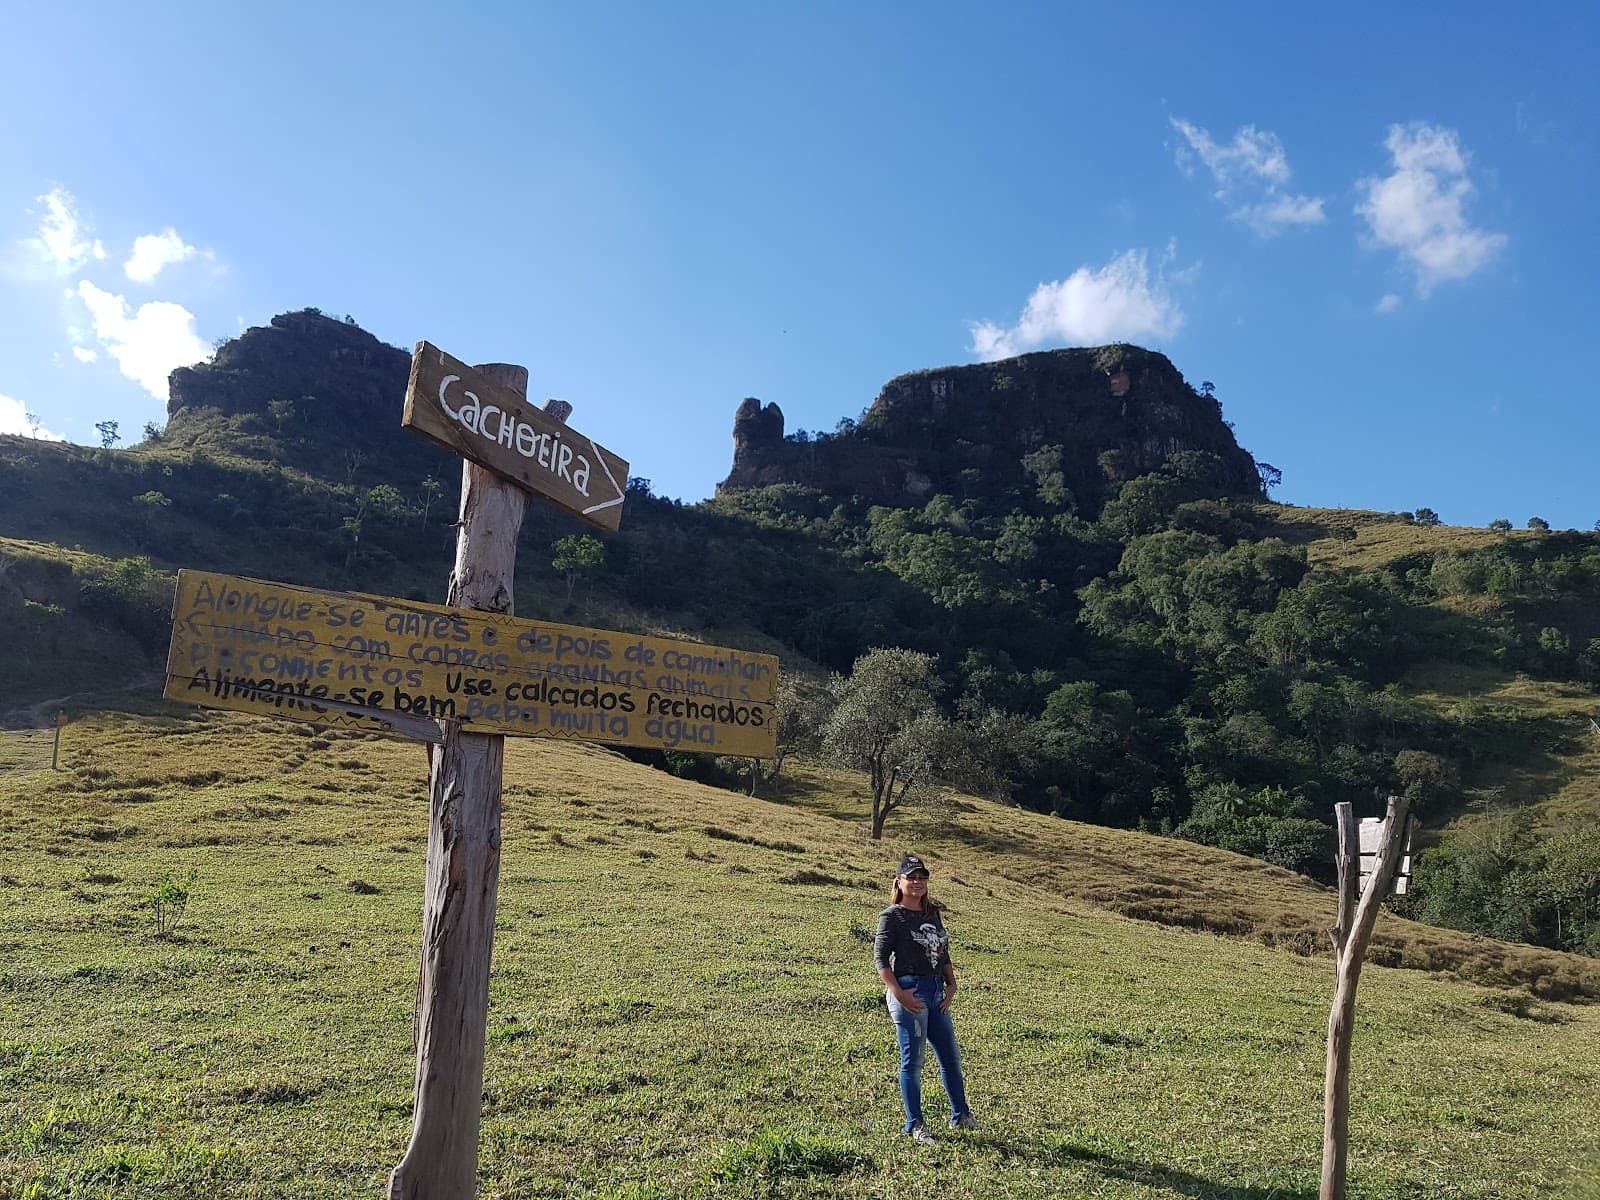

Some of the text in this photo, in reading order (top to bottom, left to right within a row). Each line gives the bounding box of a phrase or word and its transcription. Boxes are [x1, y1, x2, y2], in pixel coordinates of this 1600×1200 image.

[516, 628, 613, 662] depois
[624, 641, 657, 668] de
[394, 686, 456, 718] bem
[466, 697, 540, 727] Beba
[505, 677, 636, 713] calçados
[646, 692, 764, 728] fechados
